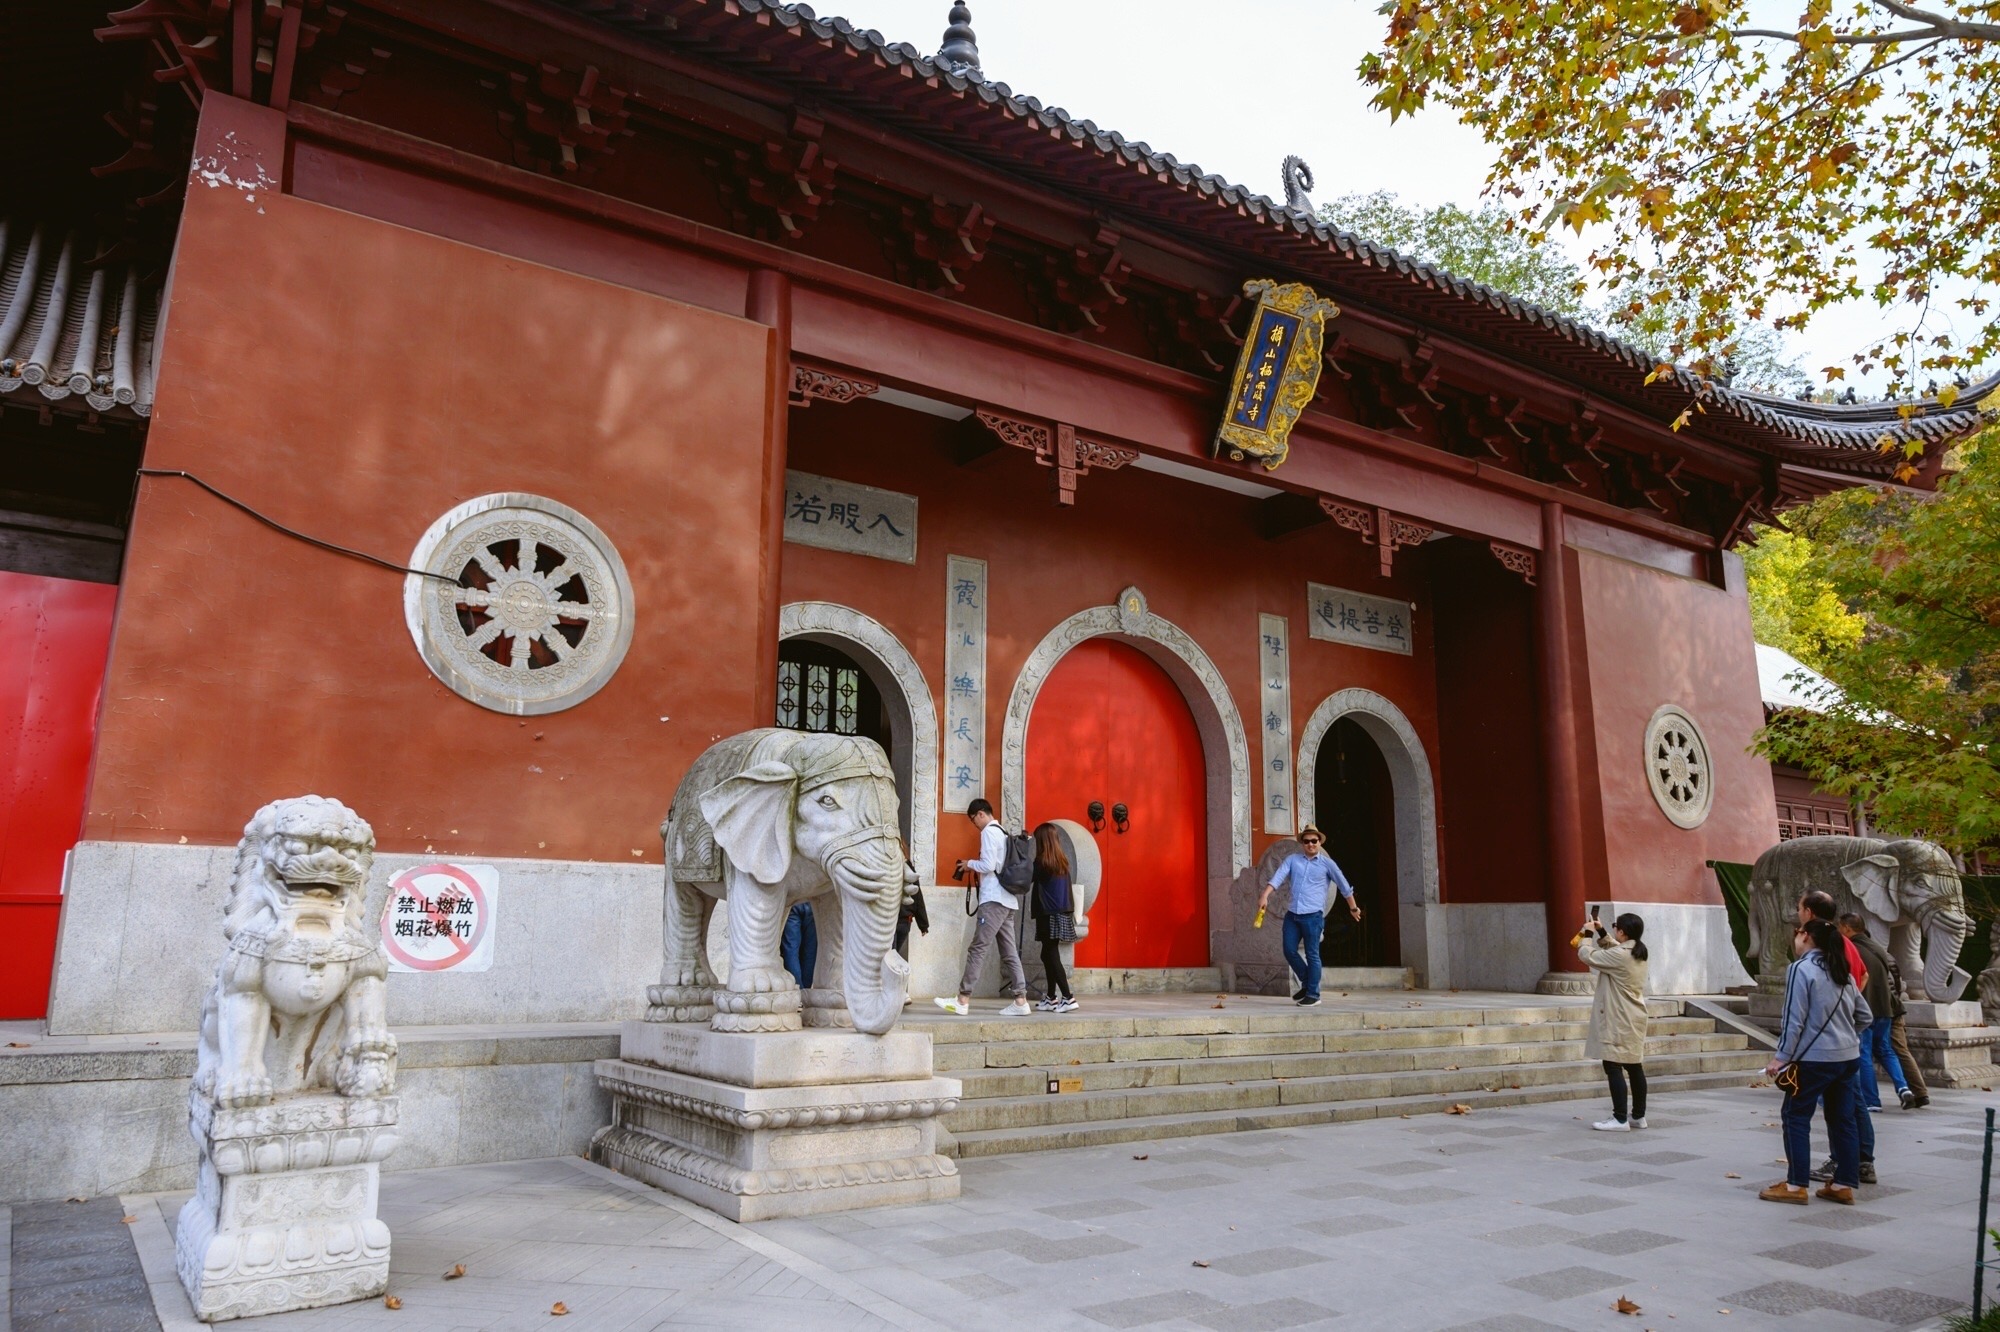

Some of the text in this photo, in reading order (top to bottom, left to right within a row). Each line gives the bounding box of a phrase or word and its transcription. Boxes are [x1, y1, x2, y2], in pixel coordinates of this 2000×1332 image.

[784, 490, 905, 537] 入般若
[398, 896, 474, 914] 禁止燃放
[395, 919, 472, 938] 烟花爆竹
